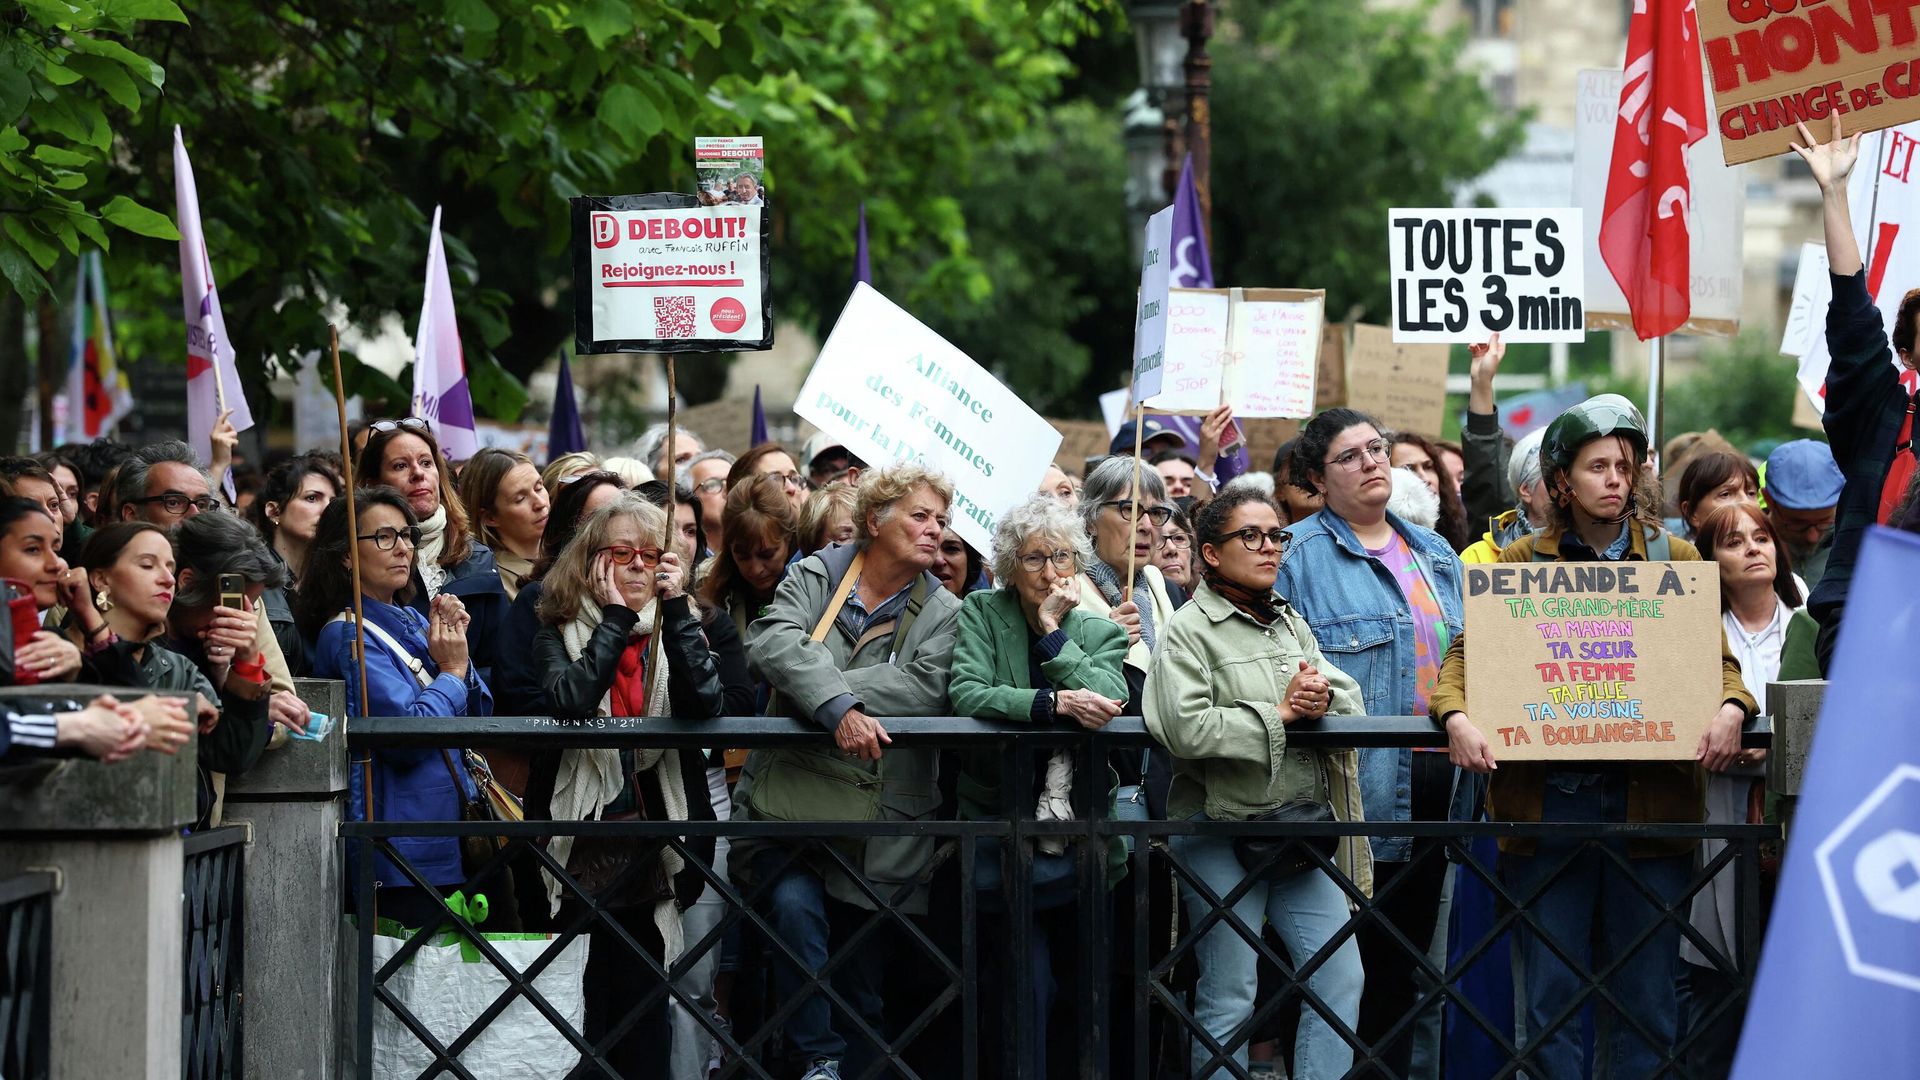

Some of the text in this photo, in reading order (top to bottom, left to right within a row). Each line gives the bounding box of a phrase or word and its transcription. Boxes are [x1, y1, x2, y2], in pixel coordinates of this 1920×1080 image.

[1719, 81, 1849, 140] CHANGE
[1848, 82, 1884, 111] DE
[1883, 131, 1920, 183] ET
[628, 217, 746, 240] DEBOUT!
[1393, 217, 1565, 278] TOUTES
[601, 263, 726, 280] Rejoignez-nous
[1398, 274, 1583, 333] LES 3 min
[906, 352, 993, 423] Alliance
[1175, 377, 1208, 392] STOP
[815, 391, 870, 433] pour
[870, 423, 891, 450] la
[866, 373, 995, 478] des Femmes
[1469, 566, 1640, 597] DEMANDE
[1504, 596, 1665, 619] TA GRAND-MÈRE
[1536, 620, 1633, 639] TA MAMAN
[1546, 640, 1638, 660] TA SŒUR
[1535, 661, 1636, 683] TA FEMME
[1547, 685, 1574, 704] TA
[1523, 702, 1557, 722] TA
[1496, 719, 1676, 747] TA BOULANGÈRE
